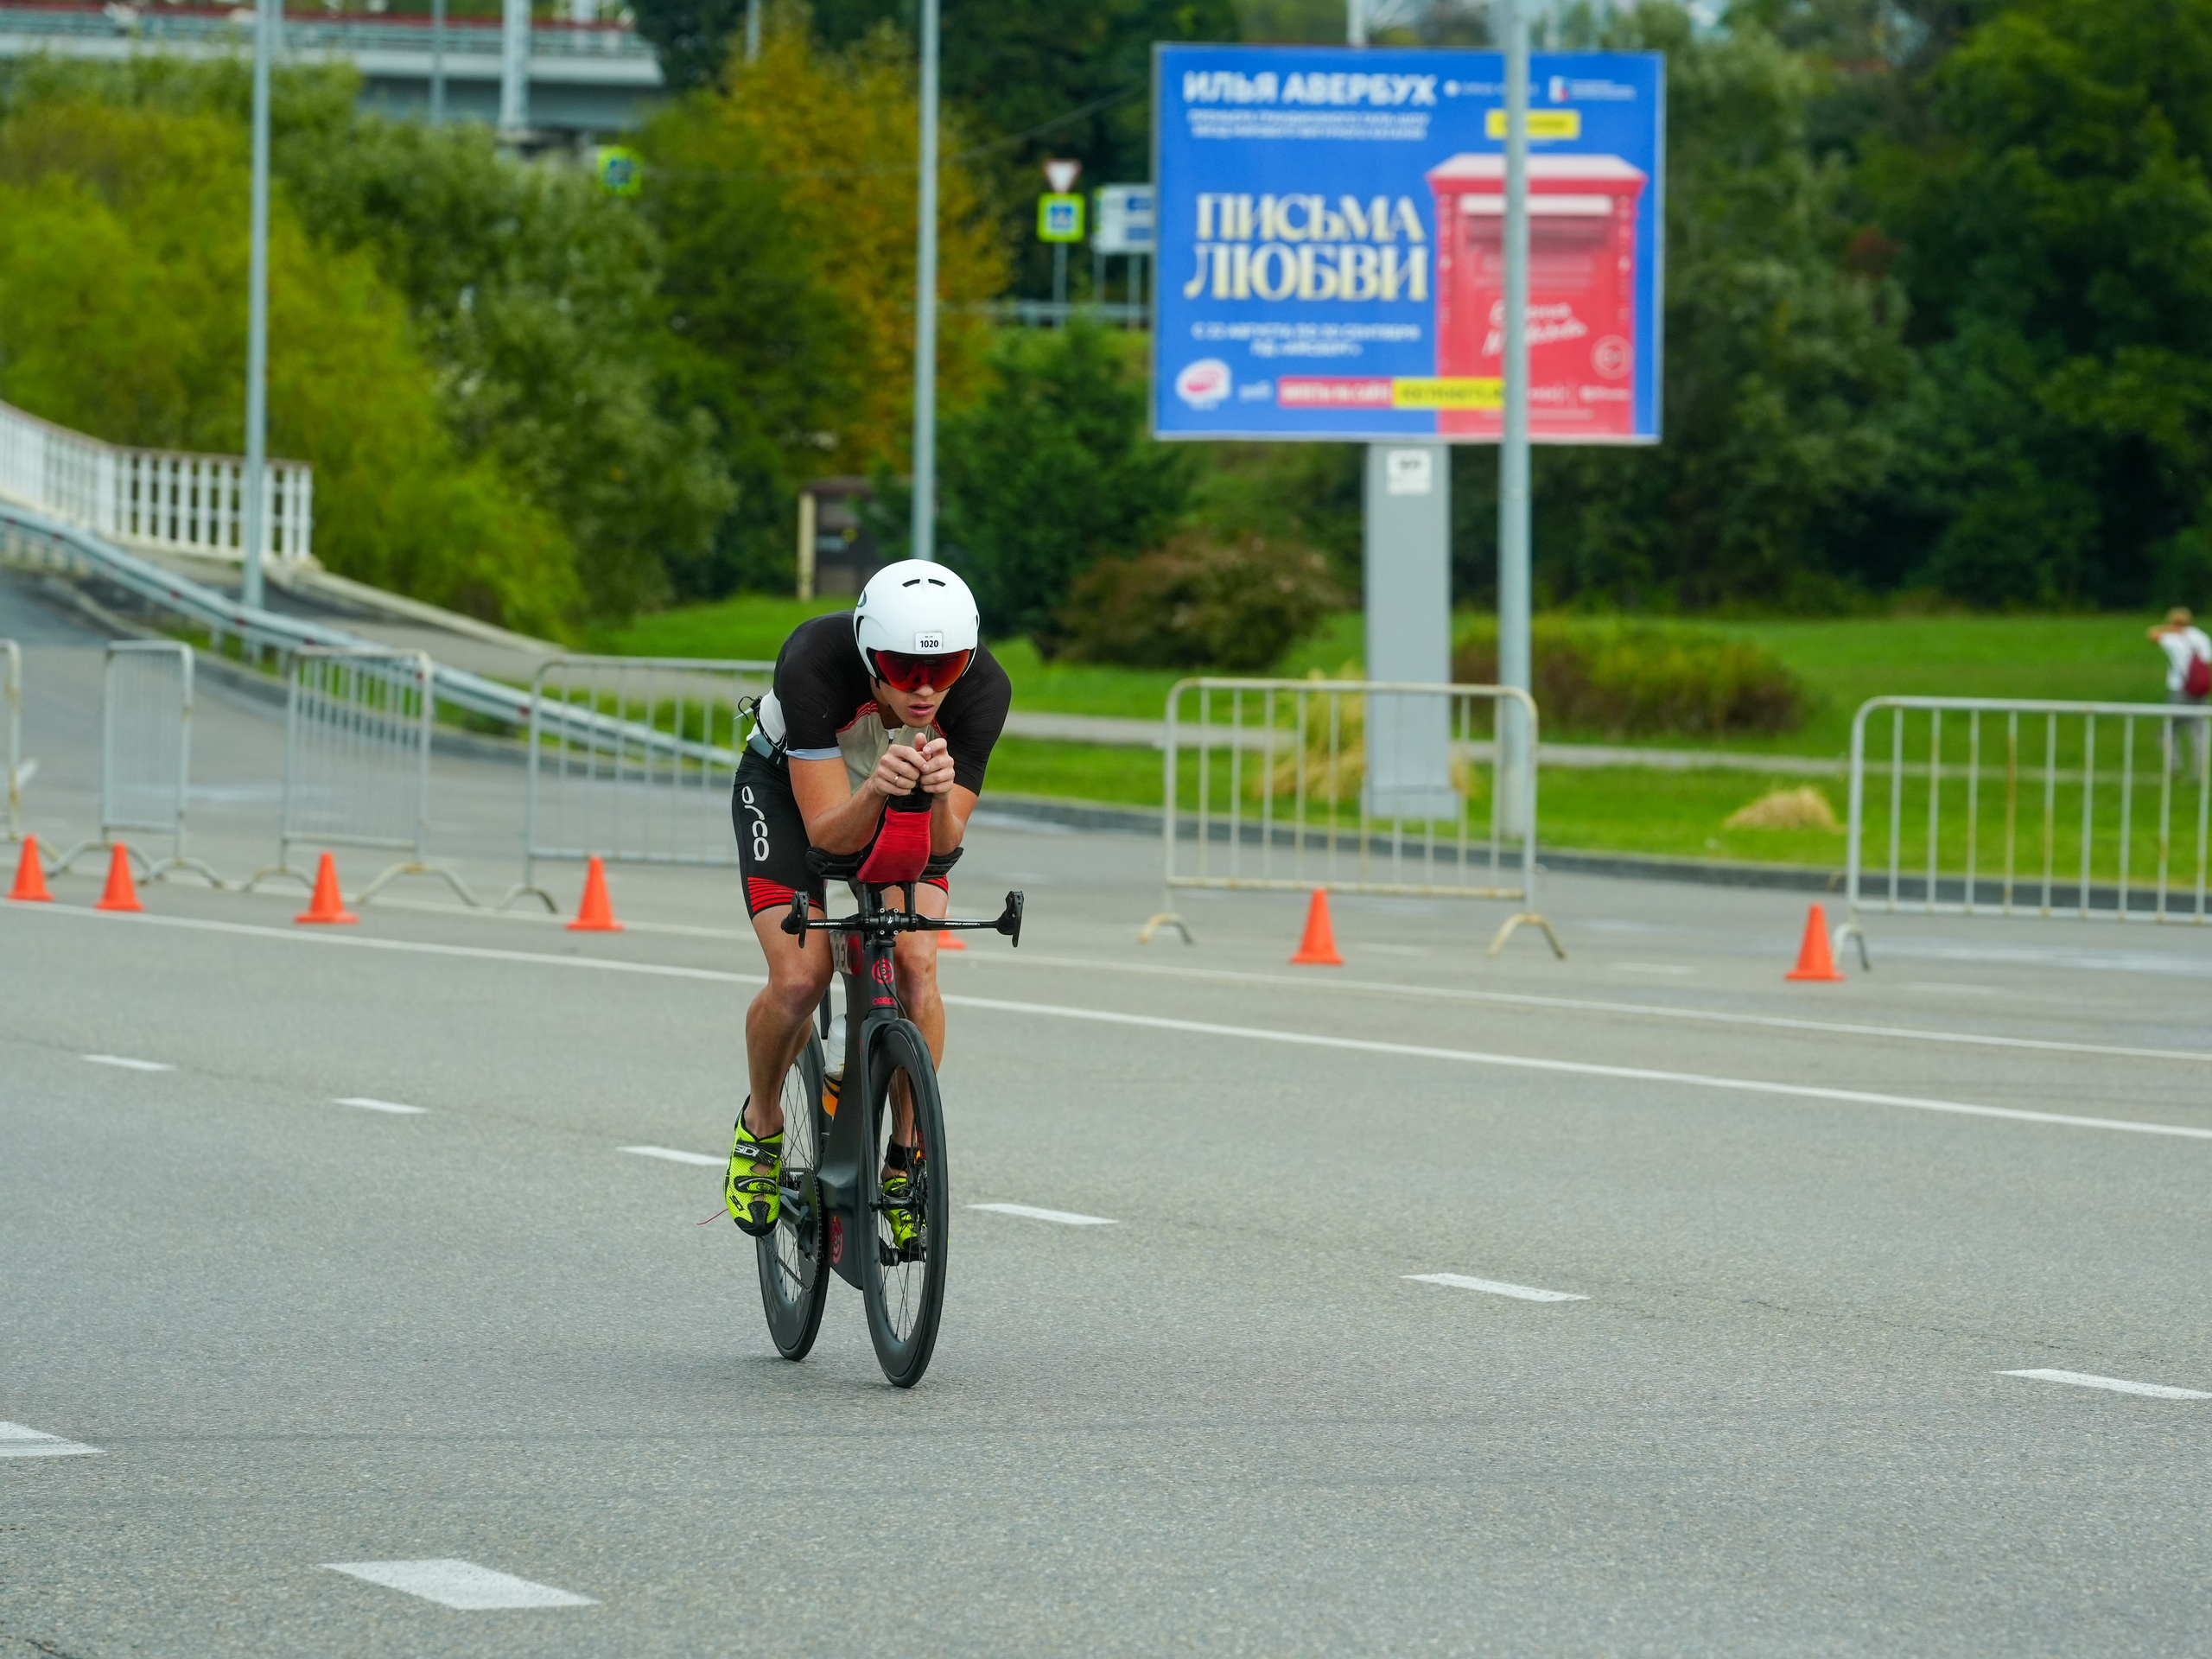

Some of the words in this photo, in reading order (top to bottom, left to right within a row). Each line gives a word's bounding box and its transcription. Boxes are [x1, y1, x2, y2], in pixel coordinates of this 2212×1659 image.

[1185, 73, 1276, 102] ИЛЬЯ
[1282, 73, 1436, 104] АВЕРБУХ
[1197, 193, 1425, 243] ПИСЬМА
[1183, 241, 1428, 302] ЛЮБВИ
[920, 639, 939, 648] 1020
[741, 785, 770, 861] orca
